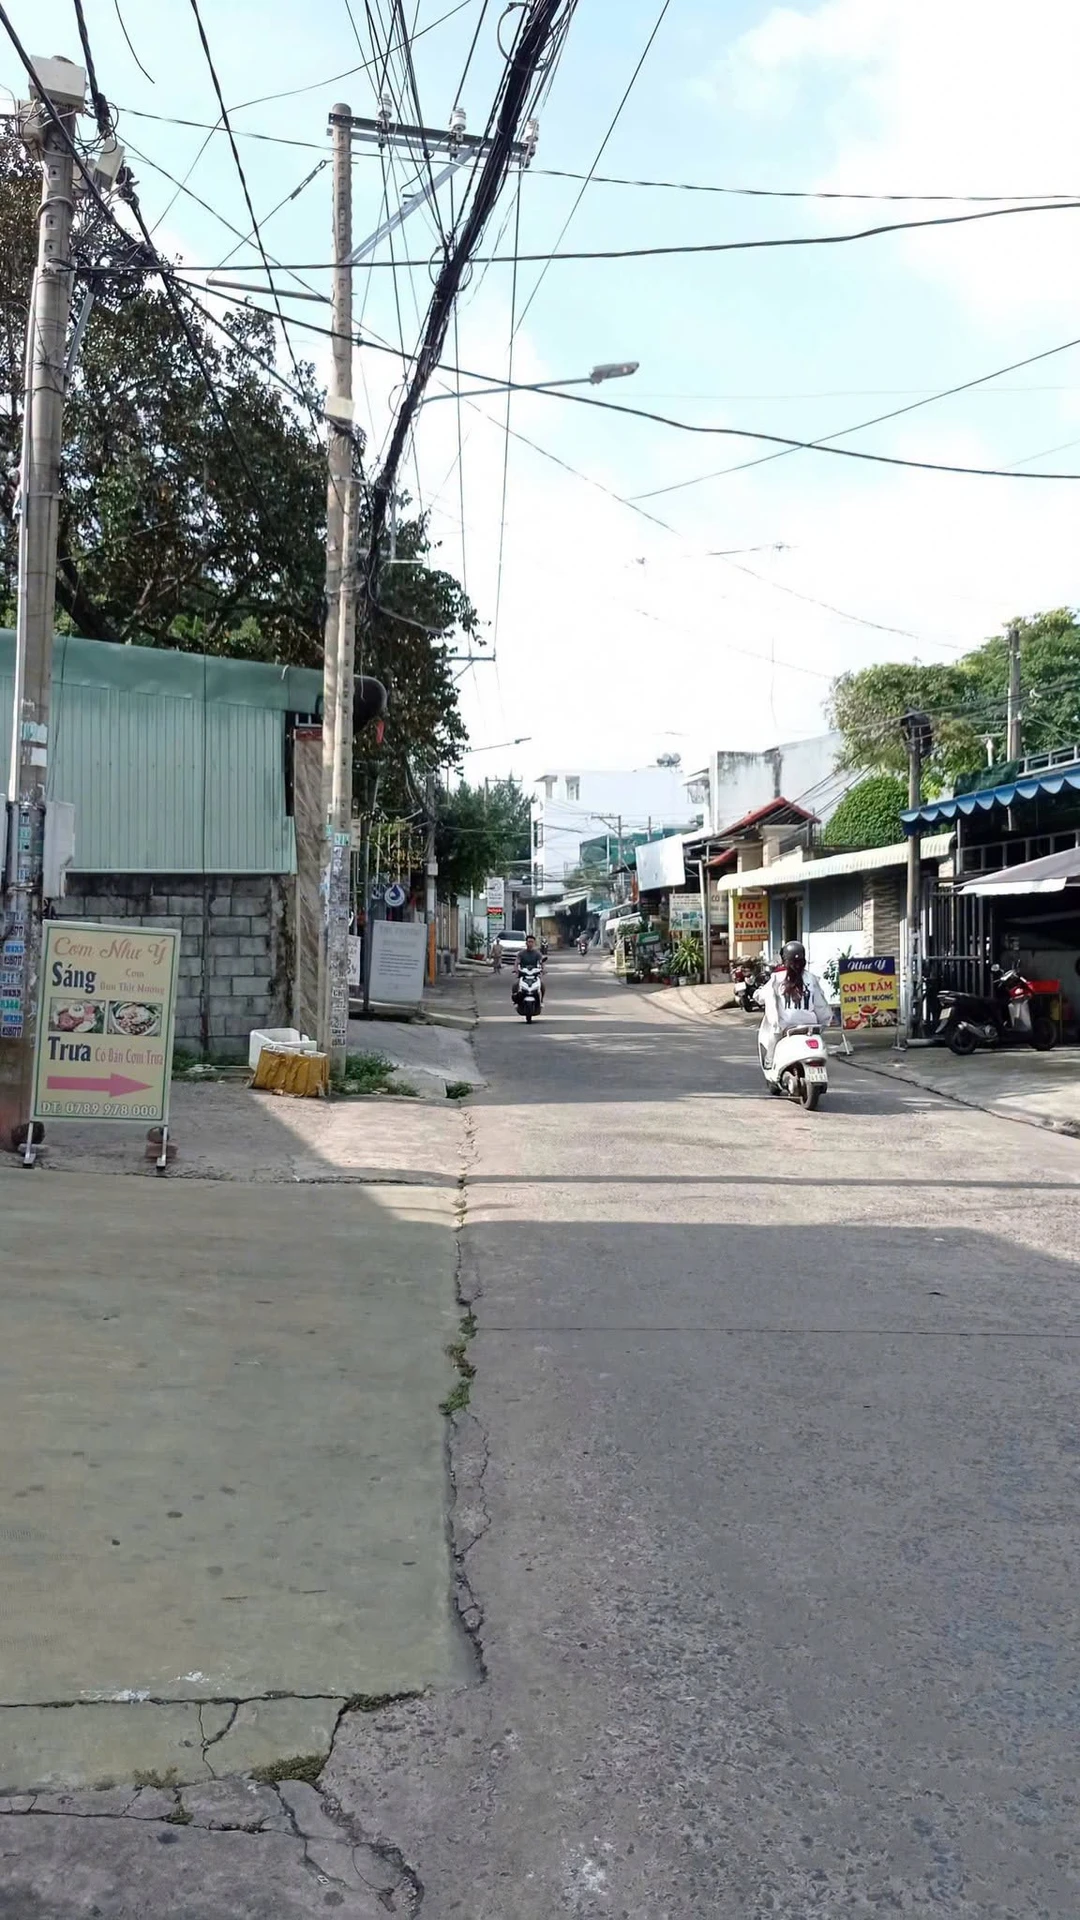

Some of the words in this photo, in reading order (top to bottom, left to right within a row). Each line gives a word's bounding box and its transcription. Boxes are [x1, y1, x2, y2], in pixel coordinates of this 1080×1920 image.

[735, 920, 767, 928] NAM
[100, 938, 143, 960] Như
[147, 938, 168, 965] Ý
[52, 961, 97, 994] Sáng
[47, 1036, 92, 1062] Trưa
[66, 1103, 99, 1114] 0789
[103, 1103, 129, 1115] 978
[132, 1105, 157, 1116] 000
